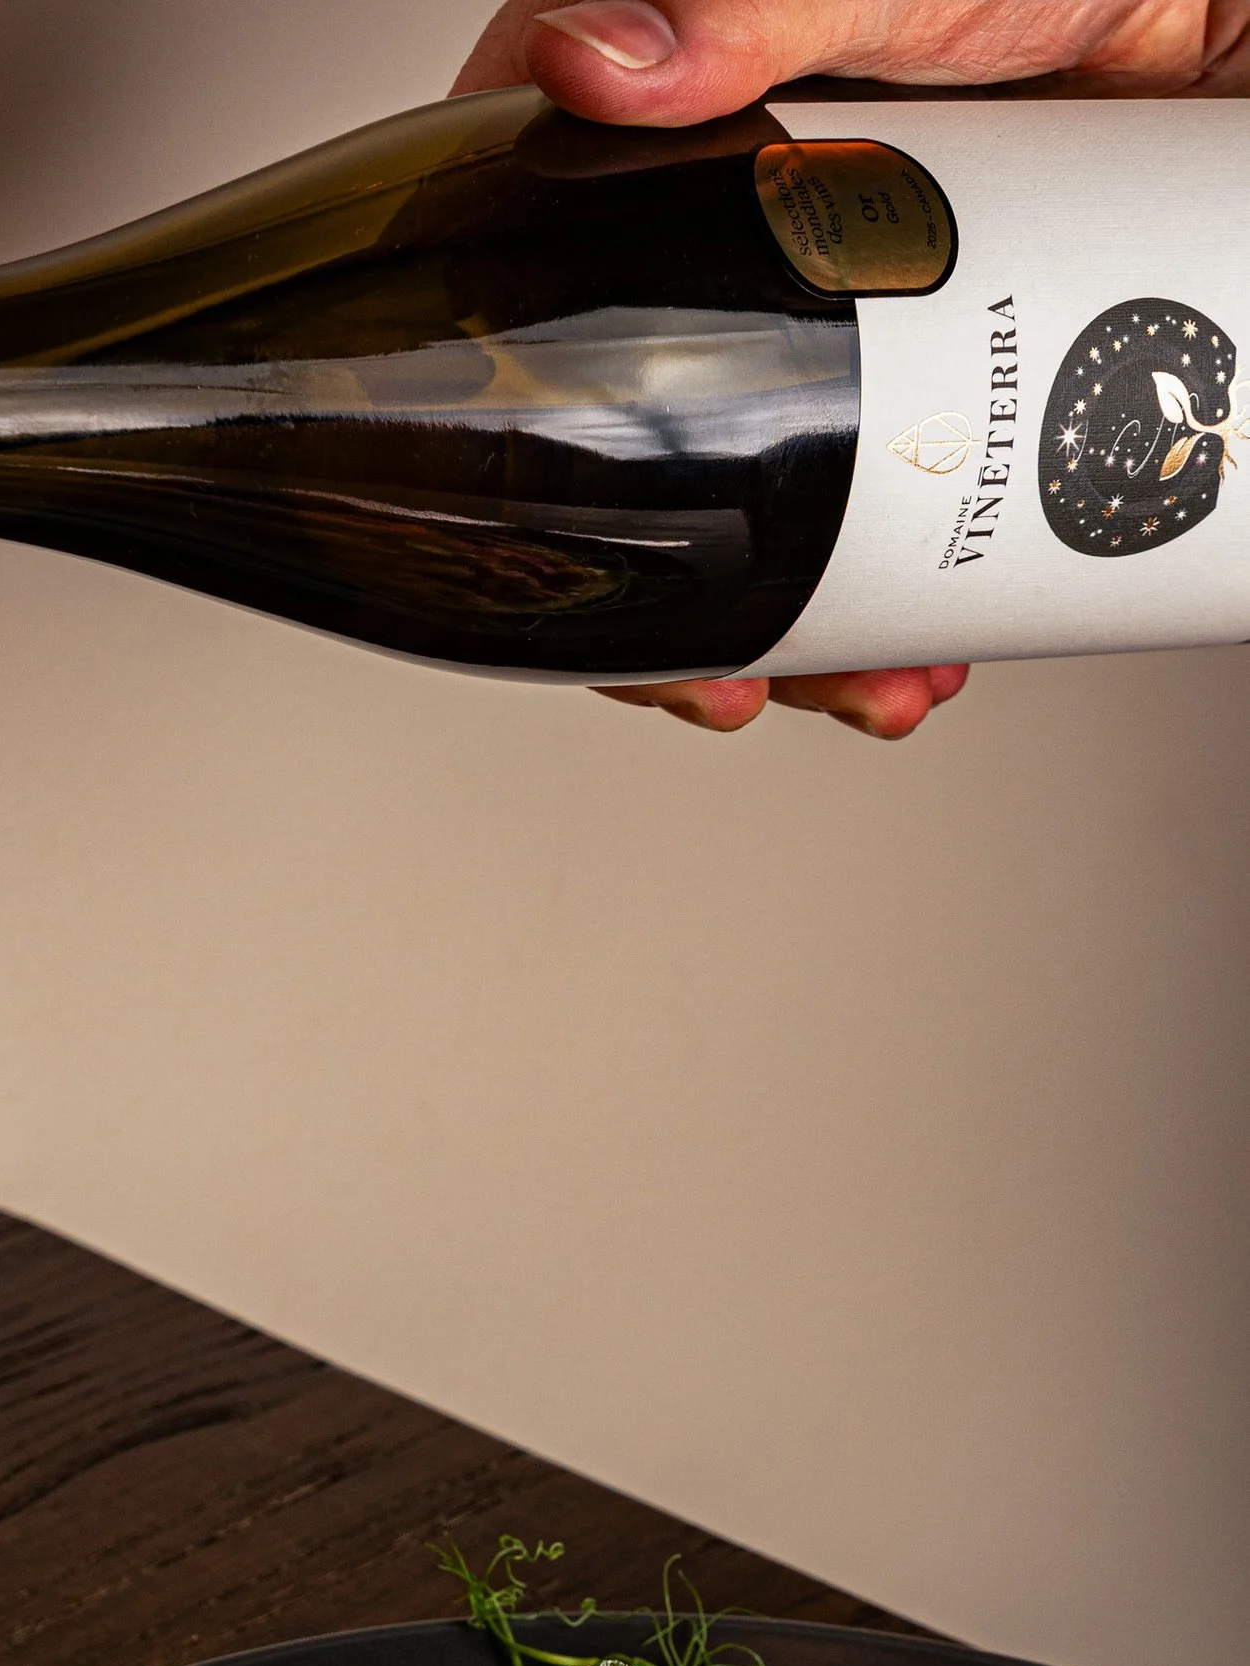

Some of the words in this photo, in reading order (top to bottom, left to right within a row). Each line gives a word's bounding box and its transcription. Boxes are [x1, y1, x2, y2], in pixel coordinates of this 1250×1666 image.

[807, 175, 836, 210] vins
[858, 193, 879, 223] Or
[878, 191, 900, 224] Gold
[900, 168, 932, 213] CANADA
[768, 168, 812, 257] sélections
[786, 167, 830, 256] mondiales
[827, 210, 843, 245] des
[926, 222, 938, 250] 2025
[938, 494, 973, 570] DOMAINE
